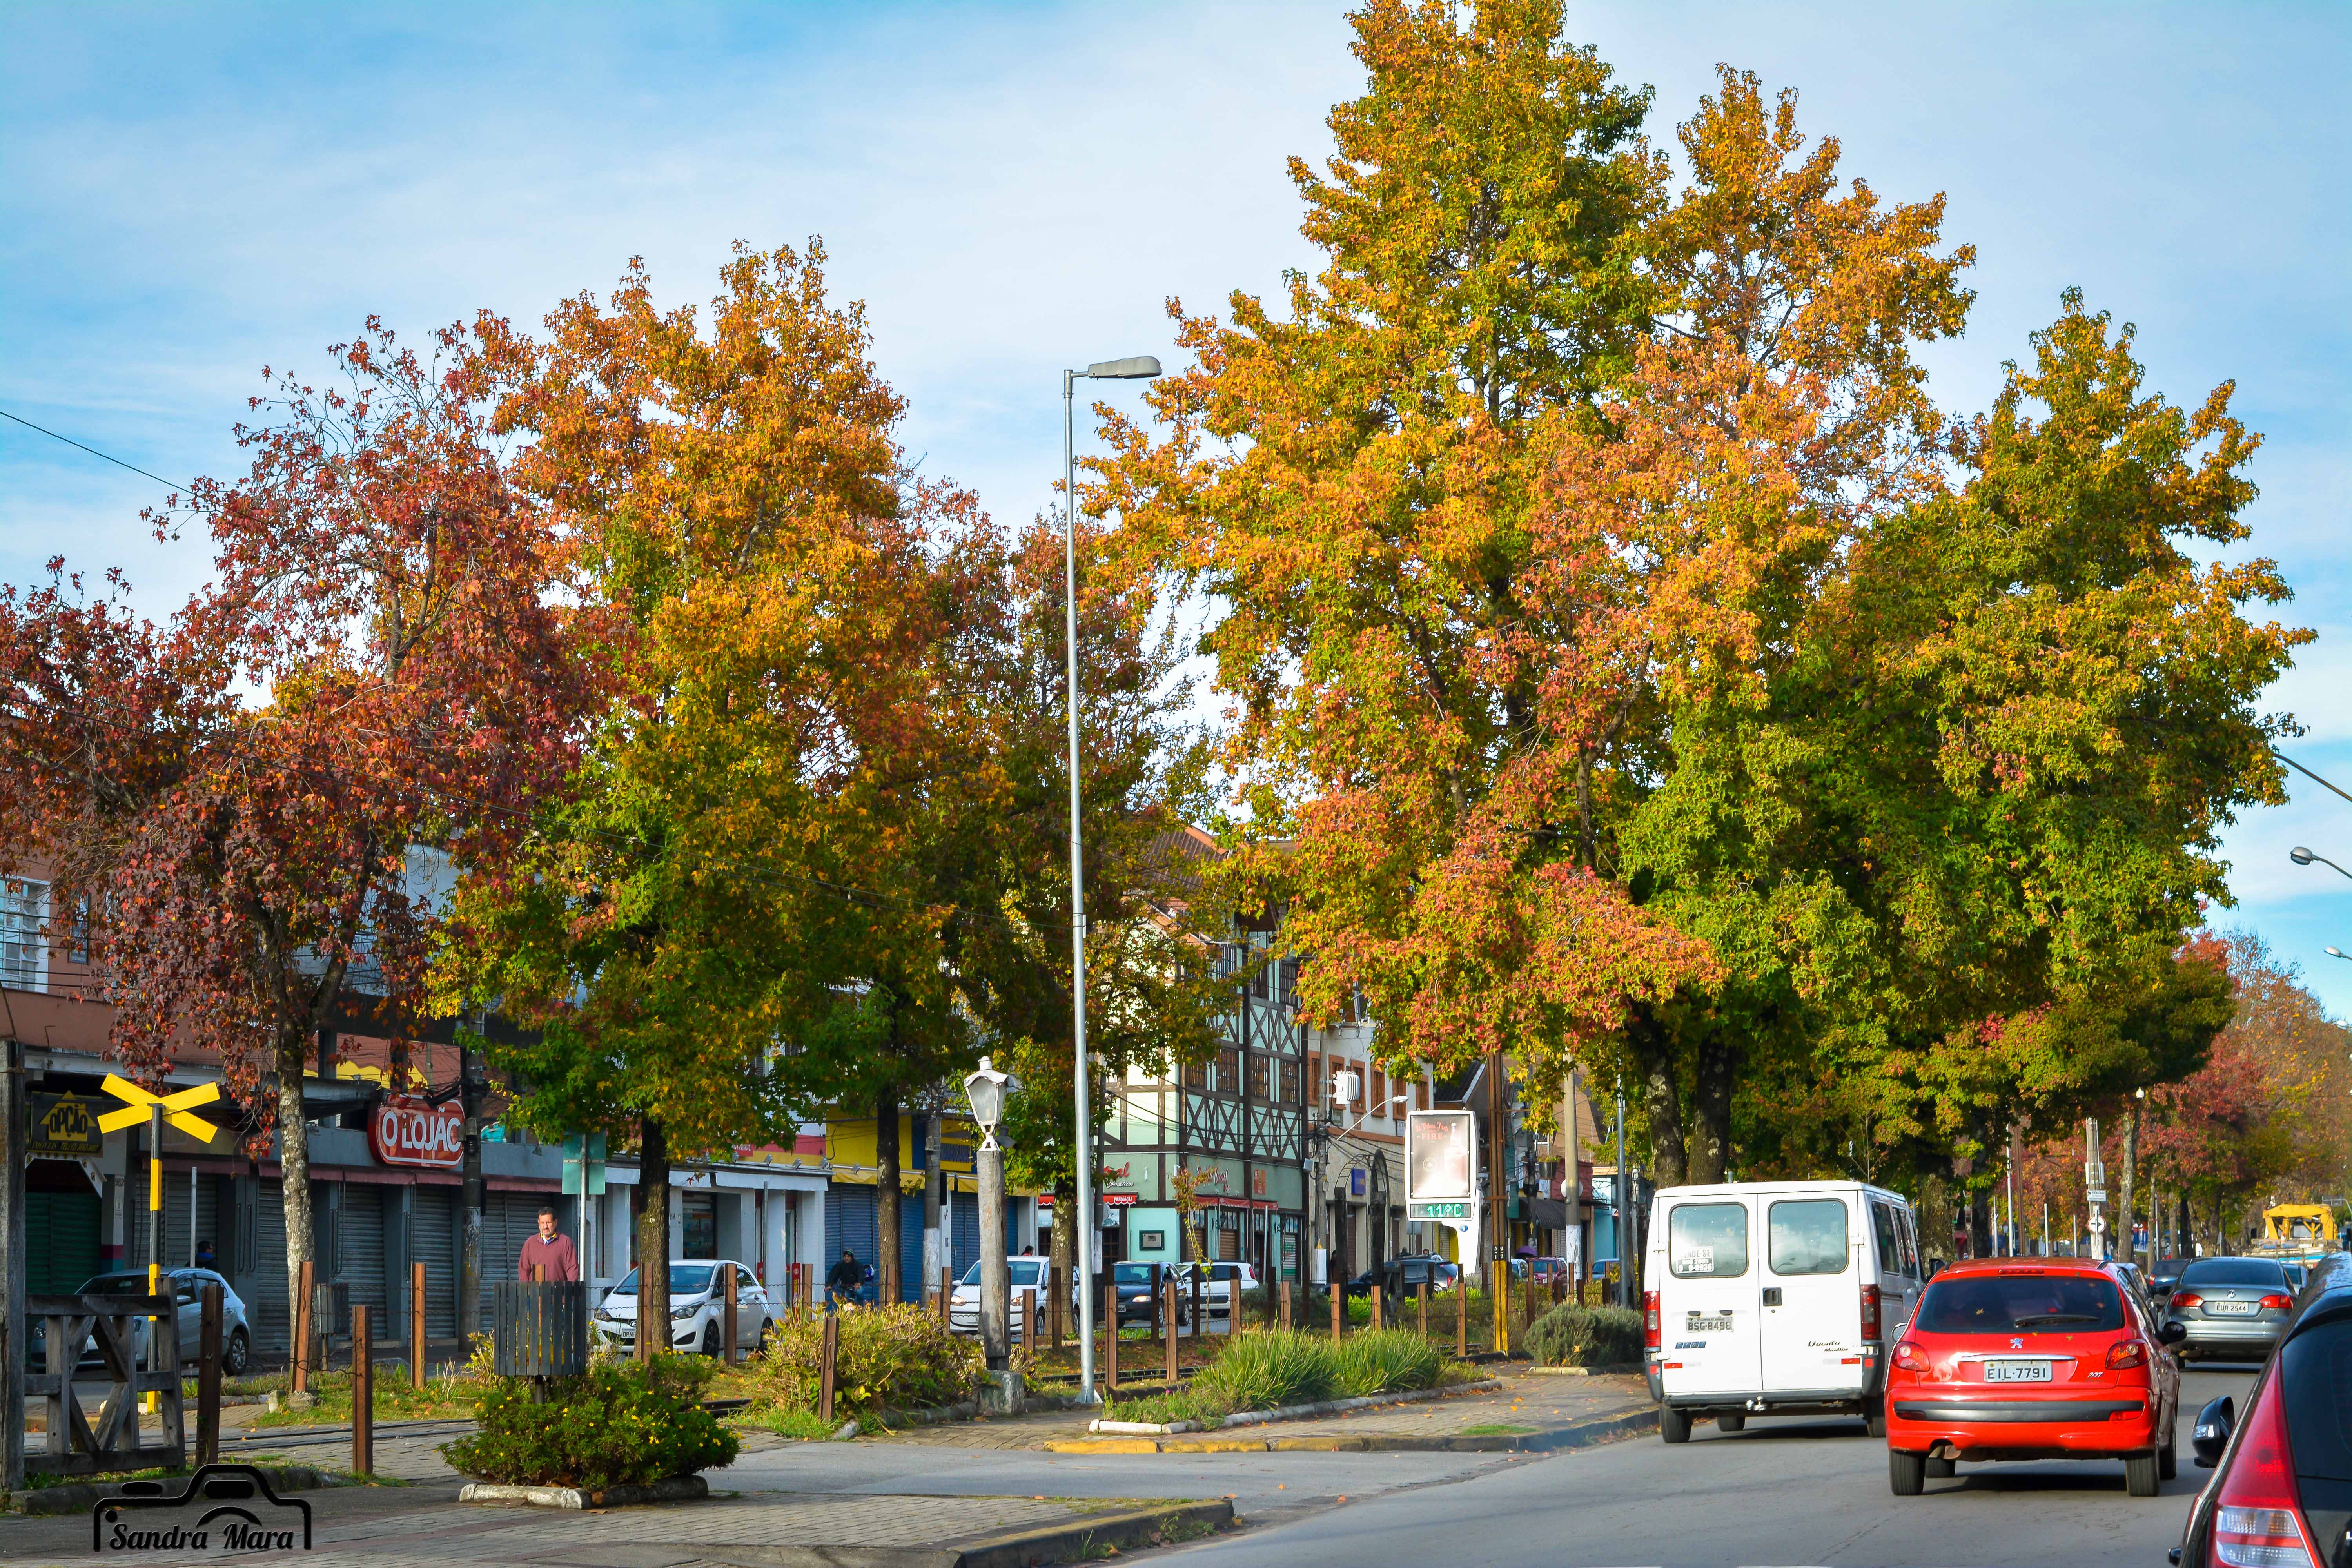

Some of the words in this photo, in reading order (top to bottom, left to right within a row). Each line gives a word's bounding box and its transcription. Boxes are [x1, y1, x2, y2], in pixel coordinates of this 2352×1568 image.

[50, 1103, 88, 1138] OPÇÃO
[382, 1111, 398, 1147] O
[402, 1107, 461, 1152] LOJÃO
[1421, 1122, 1436, 1131] Takes
[1436, 1122, 1449, 1132] Jack
[1421, 1132, 1443, 1140] FIRE
